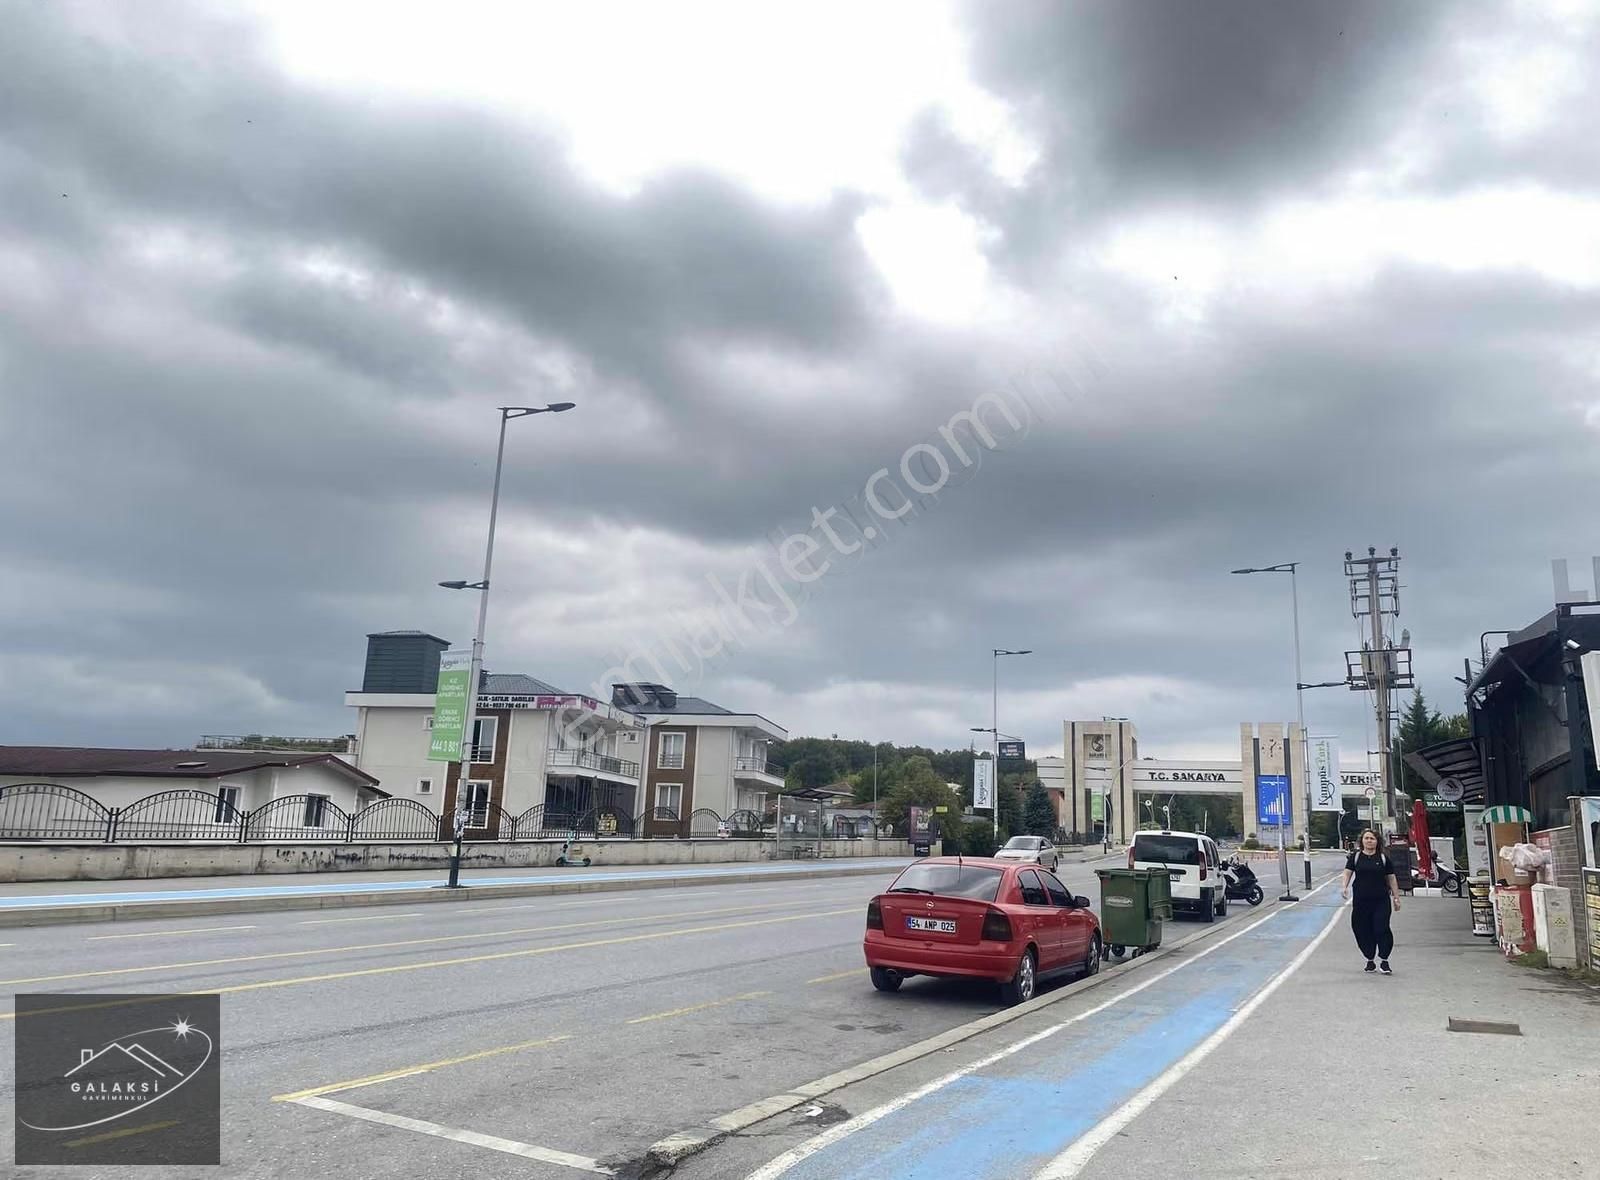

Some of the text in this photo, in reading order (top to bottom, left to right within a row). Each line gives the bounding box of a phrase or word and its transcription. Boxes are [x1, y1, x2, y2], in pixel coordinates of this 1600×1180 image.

[1148, 772, 1169, 780] T.C.
[1172, 772, 1226, 782] SAKARYA
[911, 919, 920, 928] 54
[941, 921, 955, 932] 025
